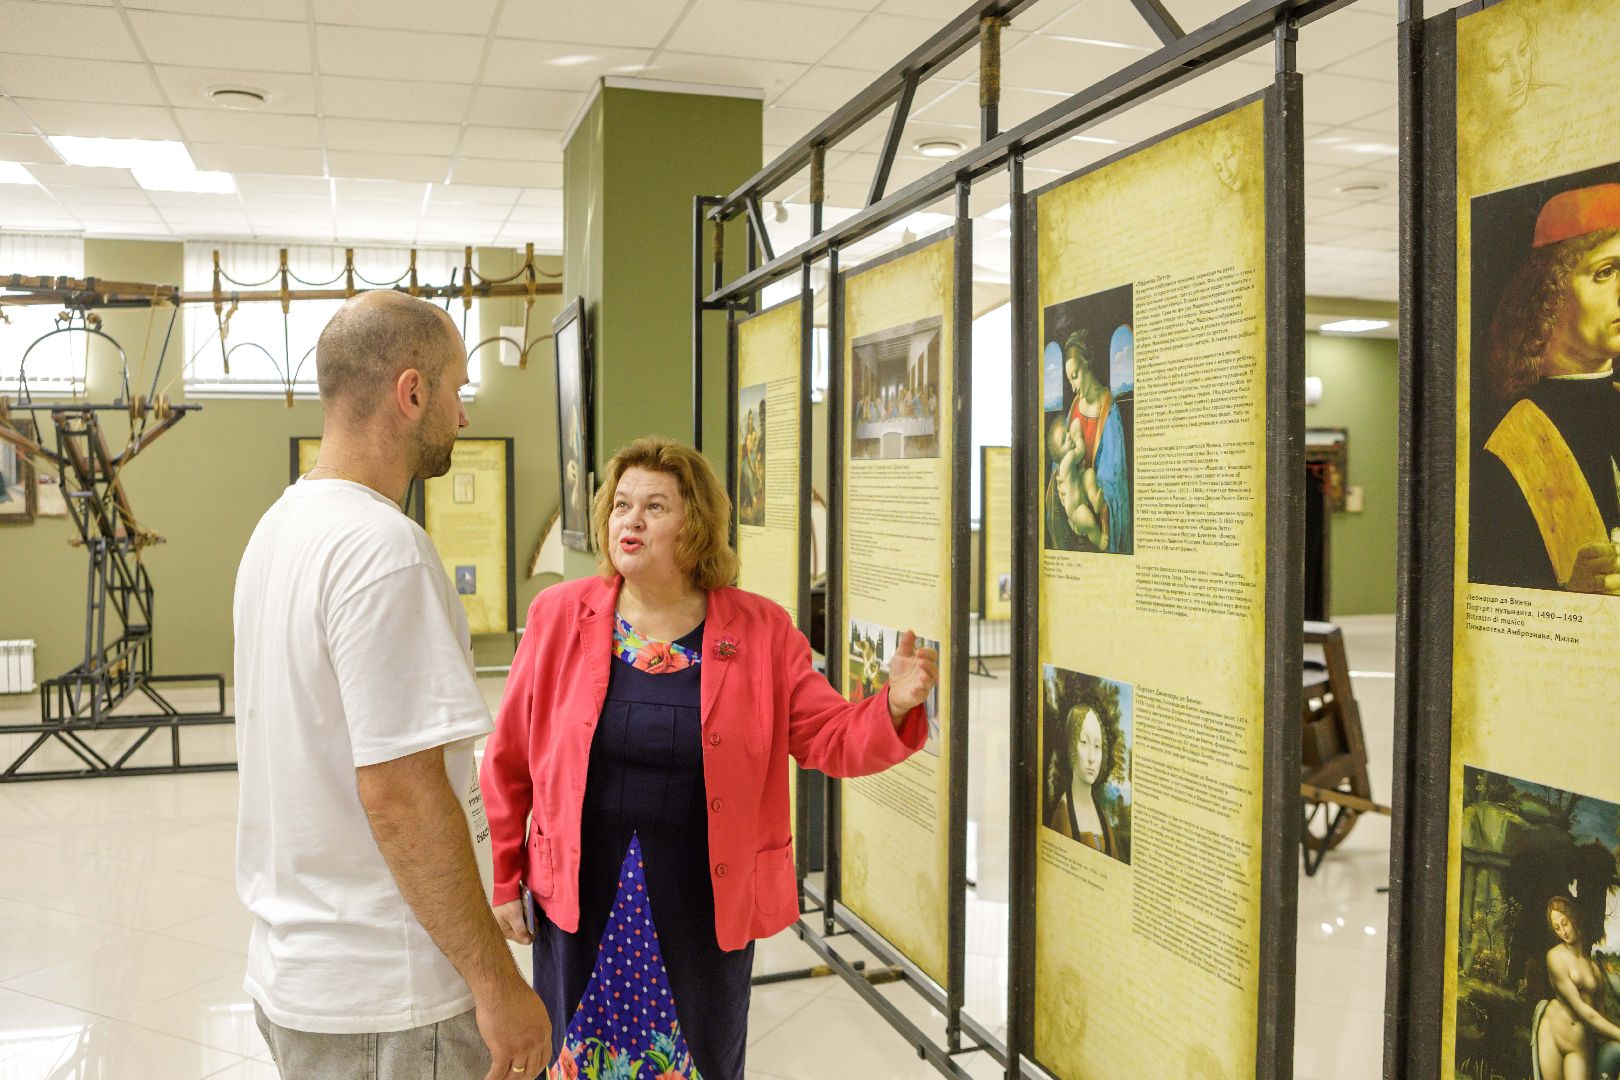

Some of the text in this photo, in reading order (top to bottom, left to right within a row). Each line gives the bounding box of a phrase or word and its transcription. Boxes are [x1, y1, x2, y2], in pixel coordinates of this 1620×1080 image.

[1466, 594, 1498, 604] Леонардо
[1510, 598, 1532, 606] Винчи
[1466, 603, 1493, 613] Портрет
[1495, 608, 1534, 617] музыканта,
[1466, 612, 1491, 622] Ritratto
[1501, 618, 1525, 626] musico
[1466, 622, 1579, 644] Пинакотека Амброзиана, Милан
